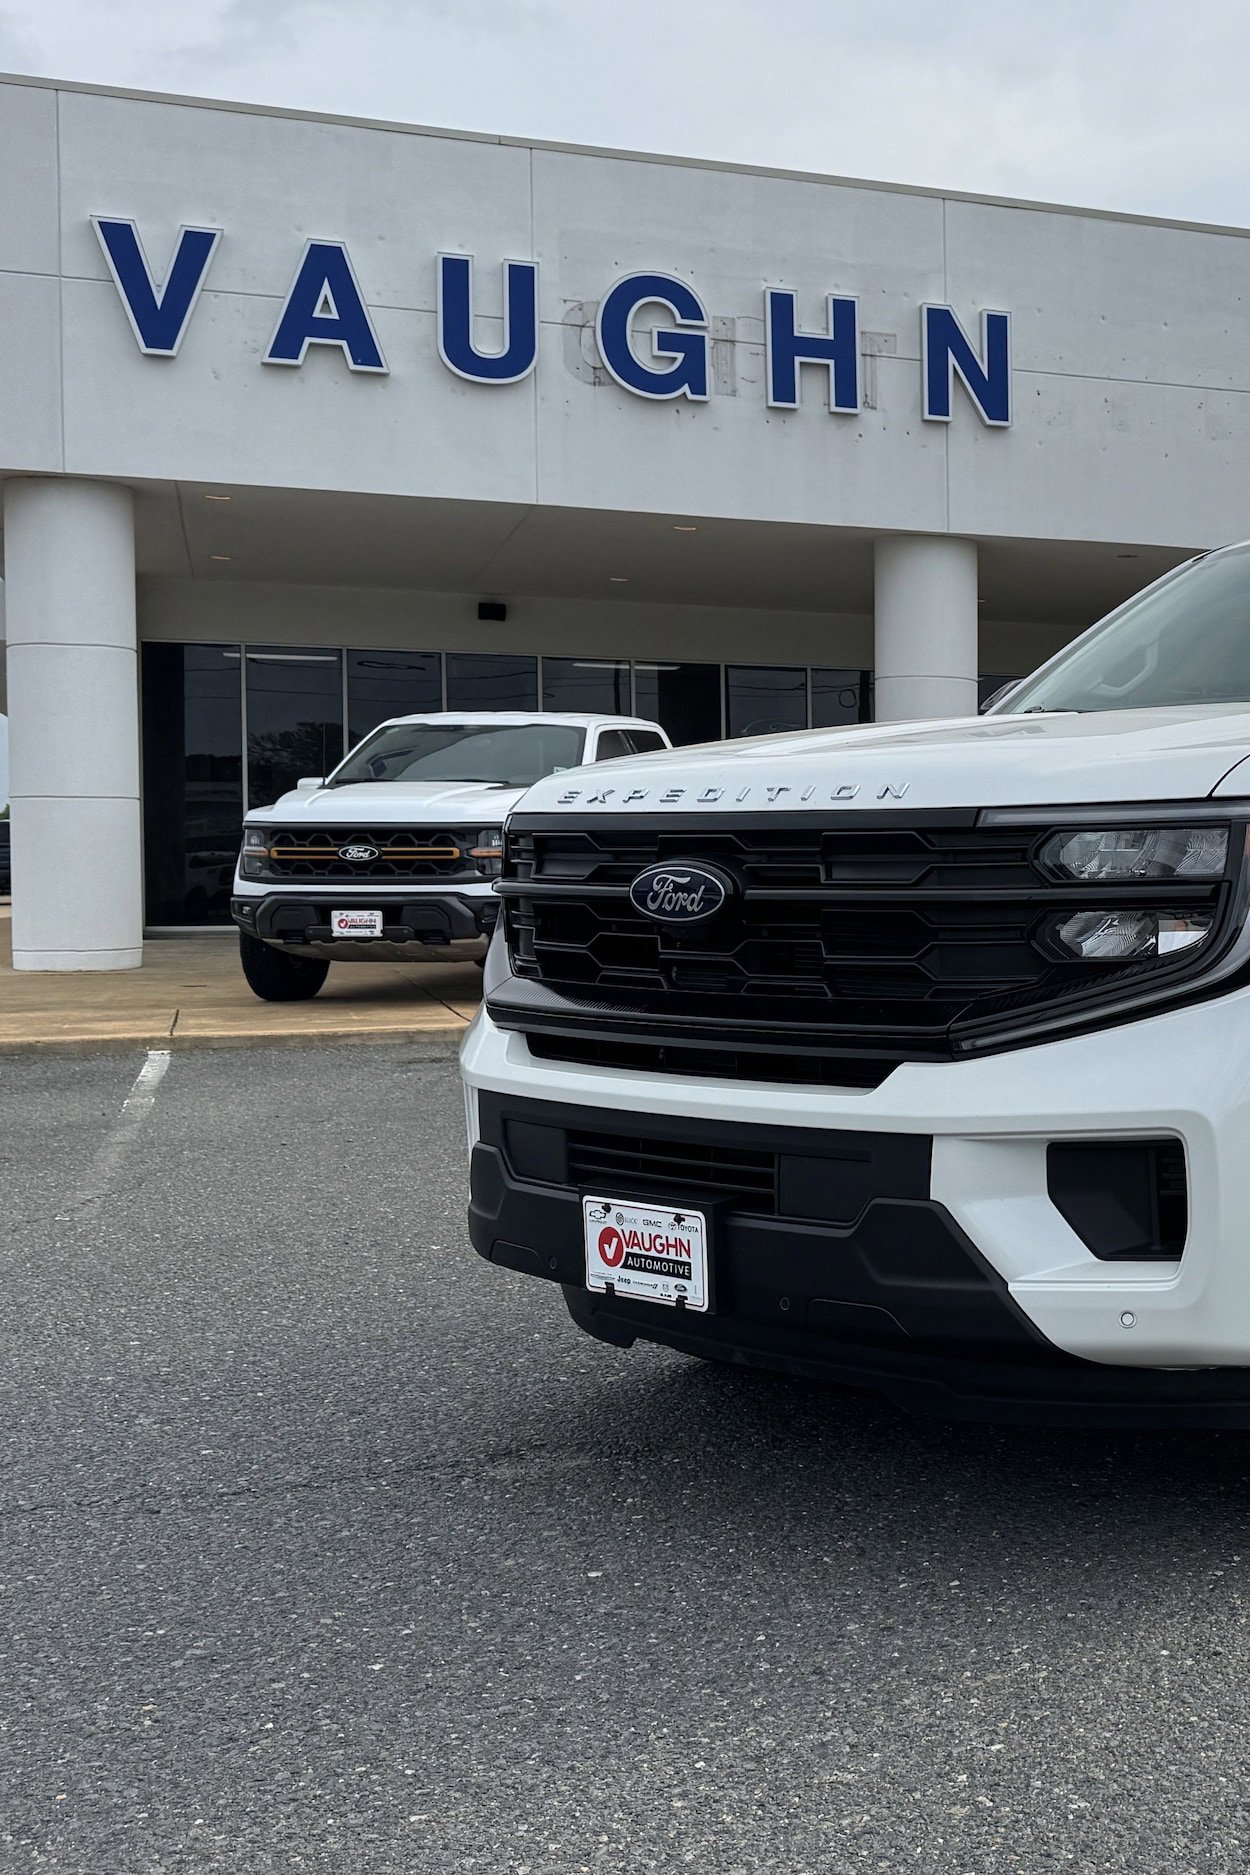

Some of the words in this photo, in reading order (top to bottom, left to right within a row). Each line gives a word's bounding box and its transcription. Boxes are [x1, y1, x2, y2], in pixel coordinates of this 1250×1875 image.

[90, 215, 1012, 428] VAUGHN
[557, 782, 911, 805] EXPEDITION
[346, 848, 370, 858] Ford
[647, 874, 705, 912] Ford
[643, 1219, 662, 1228] GMC
[621, 1229, 691, 1258] VAUGHN
[627, 1256, 689, 1276] AUTOMOTIVE
